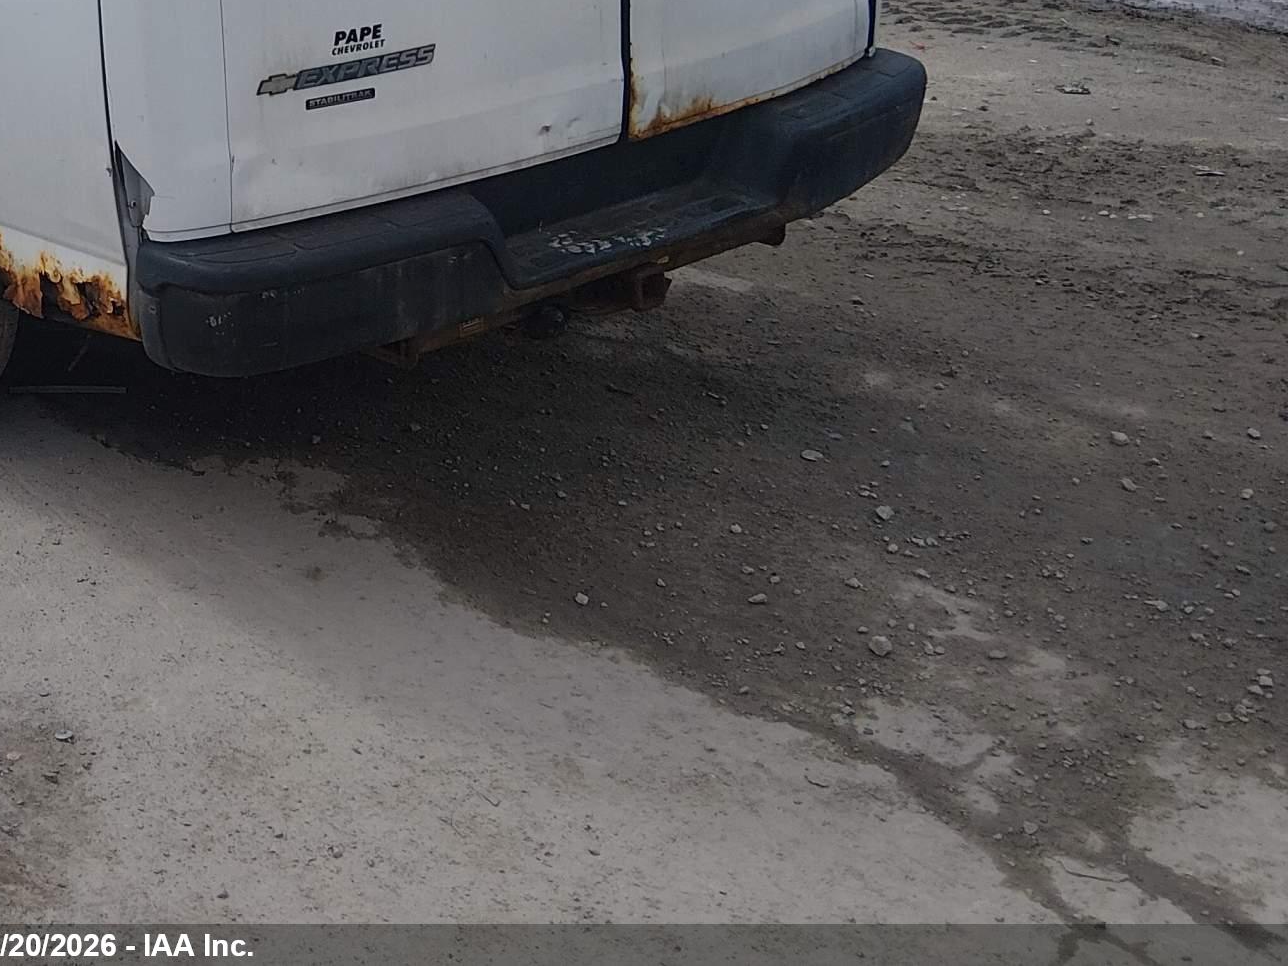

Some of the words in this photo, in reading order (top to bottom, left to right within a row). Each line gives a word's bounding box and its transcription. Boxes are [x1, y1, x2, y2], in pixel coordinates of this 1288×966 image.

[333, 23, 383, 47] PAPE
[331, 38, 386, 56] CHEVROLET
[293, 43, 436, 91] EXPRESS
[308, 89, 374, 109] STABILITRAK
